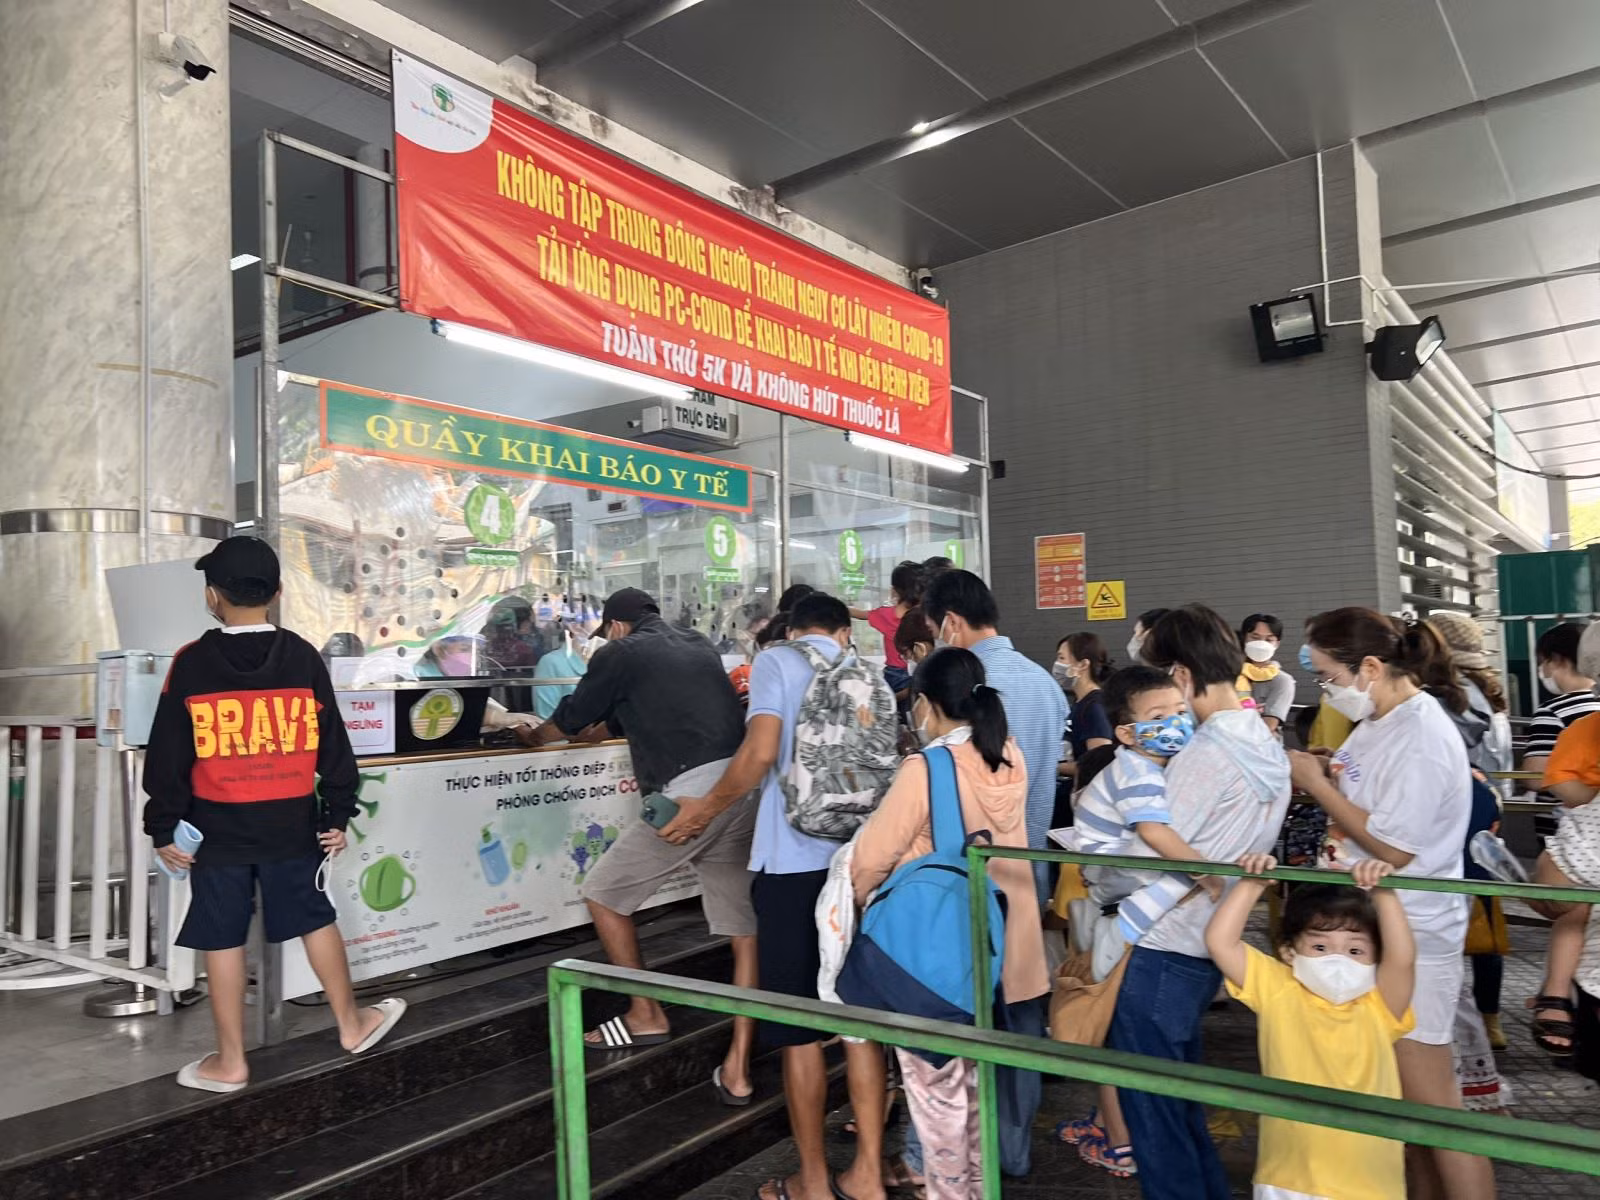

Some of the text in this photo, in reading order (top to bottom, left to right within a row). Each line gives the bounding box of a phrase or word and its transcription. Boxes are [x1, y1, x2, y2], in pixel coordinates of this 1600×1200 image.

[497, 150, 944, 367] KHÔNG TẬP TRUNG ĐÔNG NGƯỜI TRÁNH NGUY CƠ LÂY NHIỄM COVID-19
[537, 225, 930, 410] TẢI ỨNG DỤNG PC-COVID ĐỂ KHAI BÁO Y TẾ KHI ĐẾN BỆNH VIỆN
[601, 321, 900, 435] TUÂN THỦ 5K VÀ KHÔNG HÚT THUỐC LÁ
[675, 405, 727, 432] TRỰC ĐÊM
[365, 415, 729, 497] QUẦY KHAI BÁO Y TẾ
[480, 495, 502, 538] 4
[713, 523, 728, 557] 5
[845, 536, 857, 564] 6
[351, 701, 376, 713] TẠM
[446, 776, 482, 794] THỰC
[484, 770, 513, 789] HIỆN
[516, 766, 537, 783] TỐT
[540, 765, 580, 781] THÔNG
[583, 761, 606, 776] ĐIỆP
[496, 792, 540, 811] PHÒNG
[544, 785, 586, 804] CHỐNG
[589, 784, 616, 800] DỊCH
